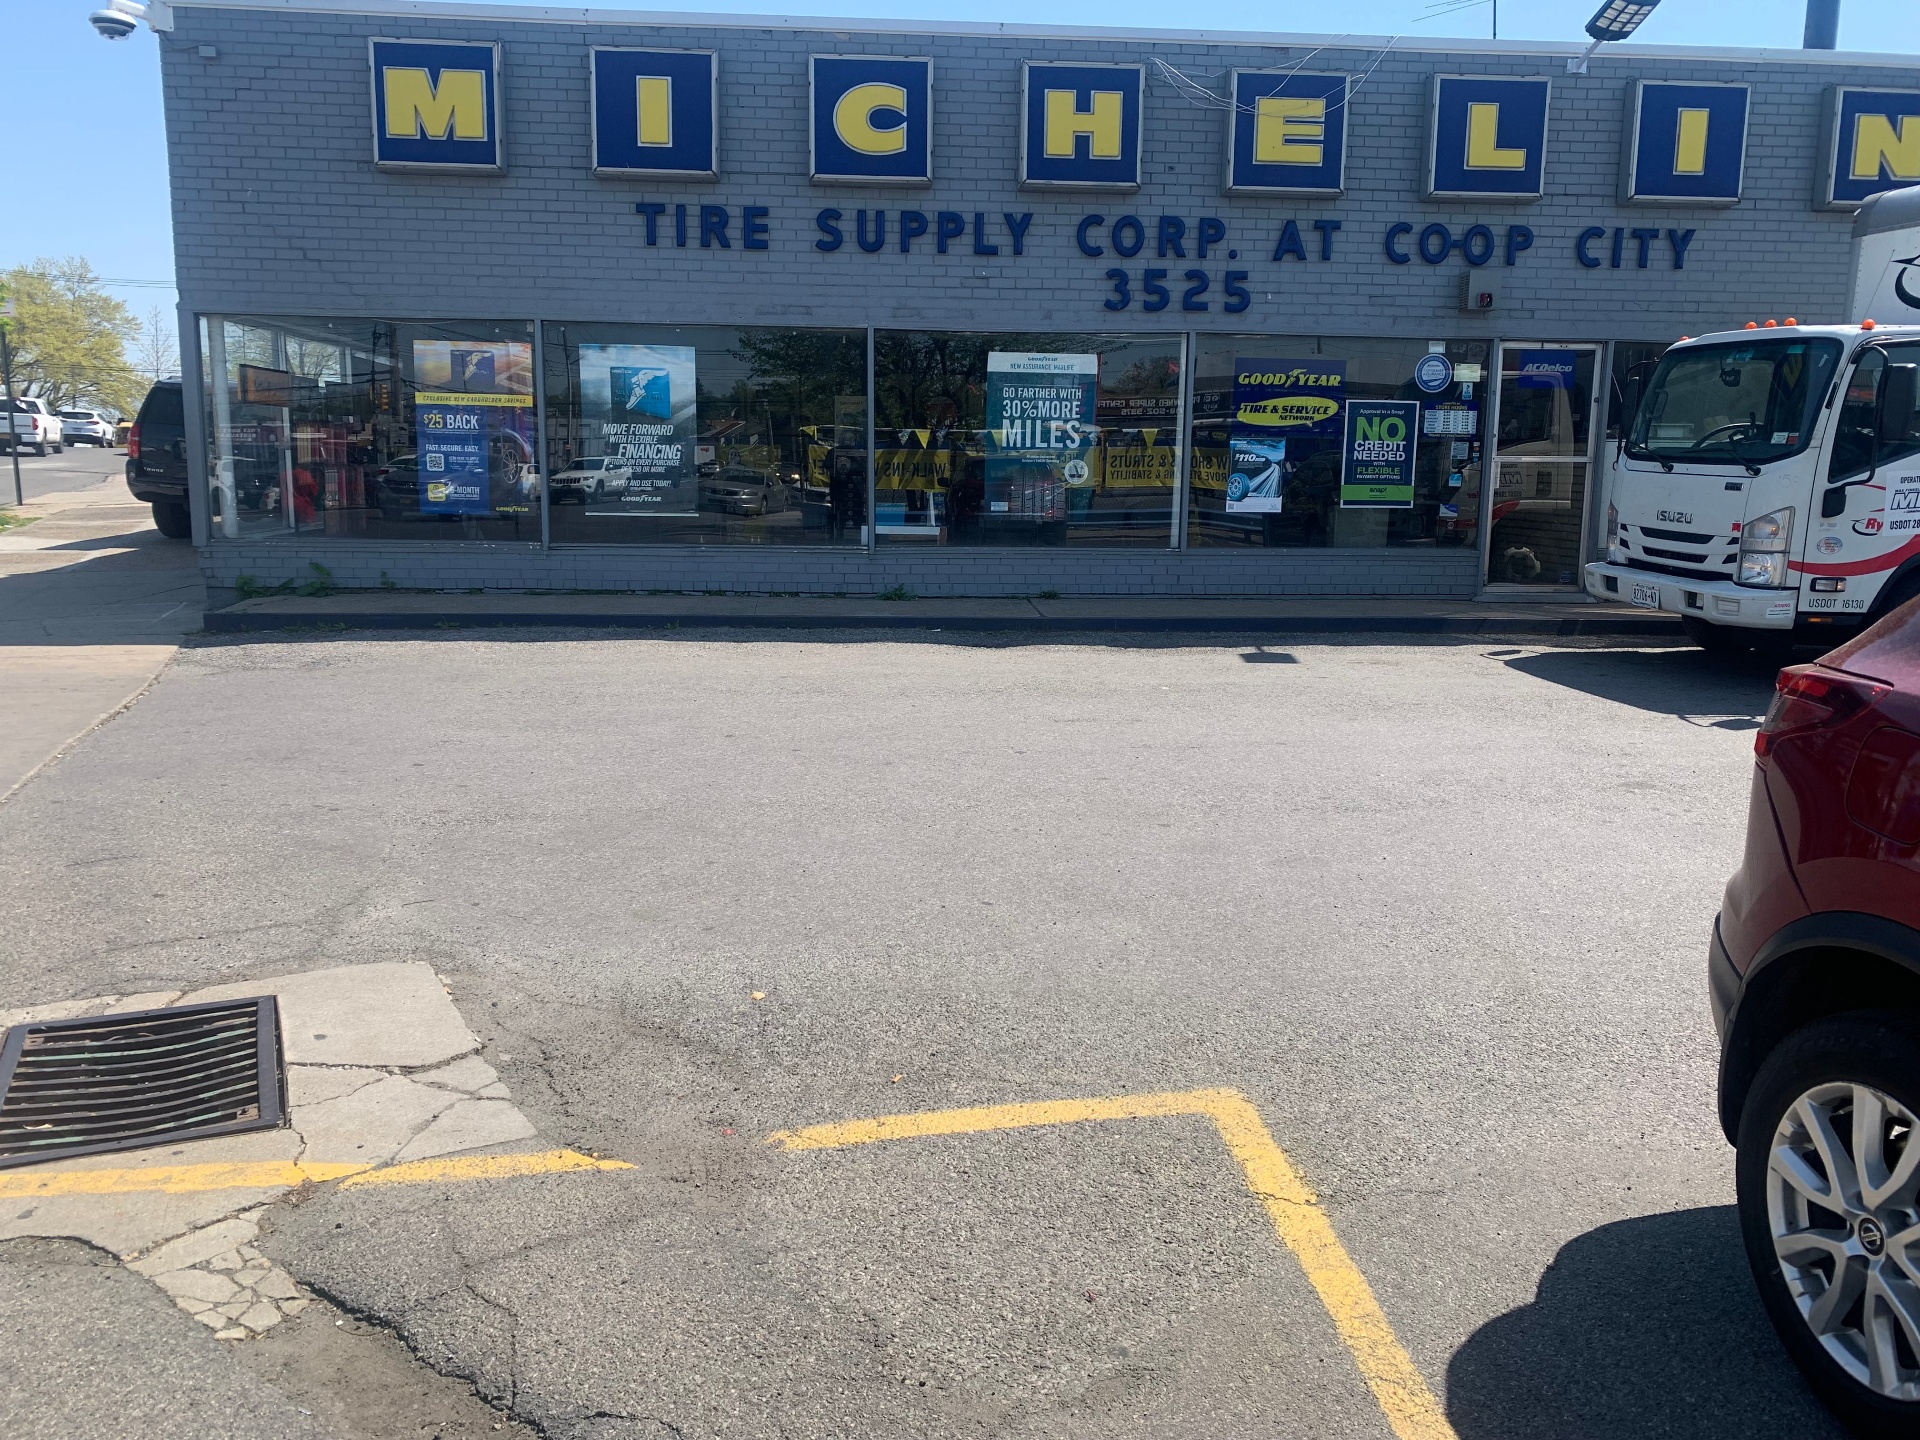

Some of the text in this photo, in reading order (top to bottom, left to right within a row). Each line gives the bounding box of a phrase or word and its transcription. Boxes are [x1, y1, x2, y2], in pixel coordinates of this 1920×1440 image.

[382, 66, 1920, 181] MICHELIN
[636, 203, 770, 250] TIRE
[815, 208, 1033, 256] SUPPLY
[1076, 214, 1239, 260] CORP.
[1273, 220, 1342, 262] AT
[1576, 227, 1696, 270] CITY
[1103, 268, 1251, 313] 3525
[1523, 364, 1573, 372] ACDelco
[1238, 371, 1341, 387] GOODYEAR
[1003, 388, 1082, 399] GO FARTHER WITH
[1242, 404, 1331, 414] TIRE & SERVICE
[424, 414, 479, 429] $25 BACK
[602, 424, 674, 436] MOVE FORWARD
[1002, 419, 1081, 448] MILES
[1356, 417, 1406, 443] NO
[610, 435, 659, 444] WITH FLEXIBLE
[618, 444, 682, 459] FINANCING
[1355, 441, 1406, 451] CREDIT
[604, 458, 627, 466] OPTIONS
[1354, 451, 1405, 461] NEEDED
[1657, 510, 1694, 524] ISUZU
[1890, 520, 1912, 530] USDOT
[1809, 599, 1864, 609] USDOT 16130
